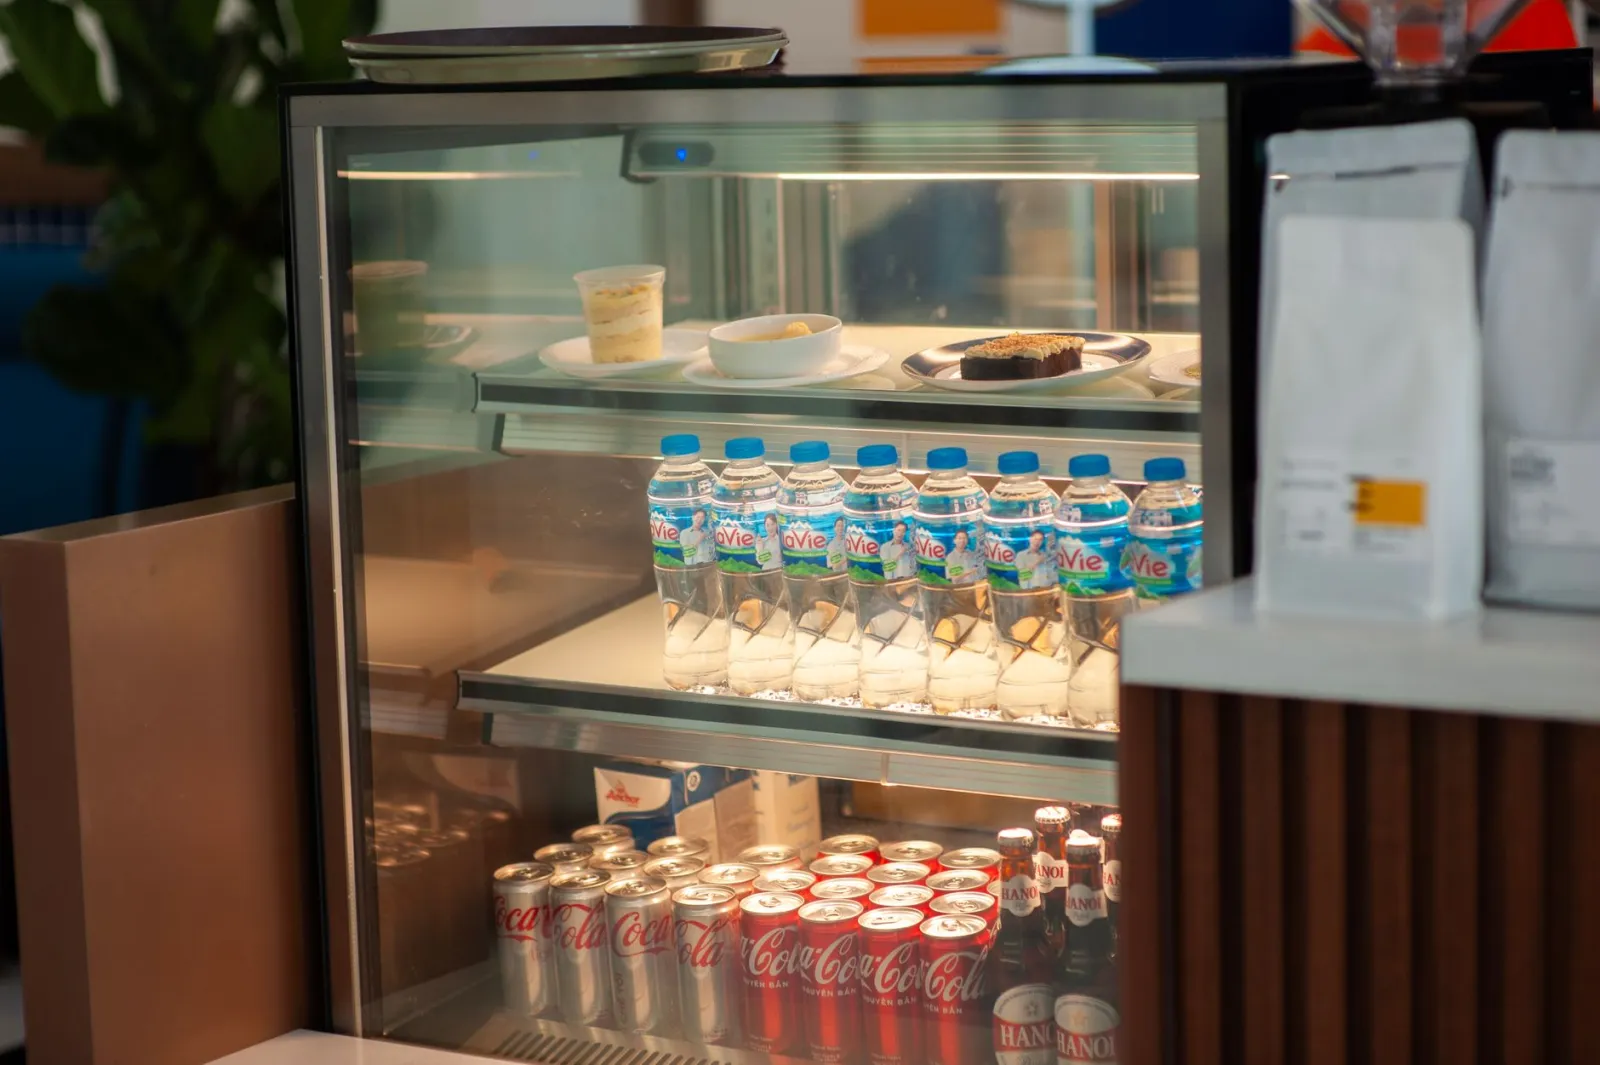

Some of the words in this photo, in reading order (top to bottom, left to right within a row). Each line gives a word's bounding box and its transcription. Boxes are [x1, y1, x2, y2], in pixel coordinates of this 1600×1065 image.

[714, 525, 754, 547] aVie
[846, 534, 879, 555] aVie
[1056, 546, 1102, 571] aVie
[1036, 864, 1064, 878] ANOI
